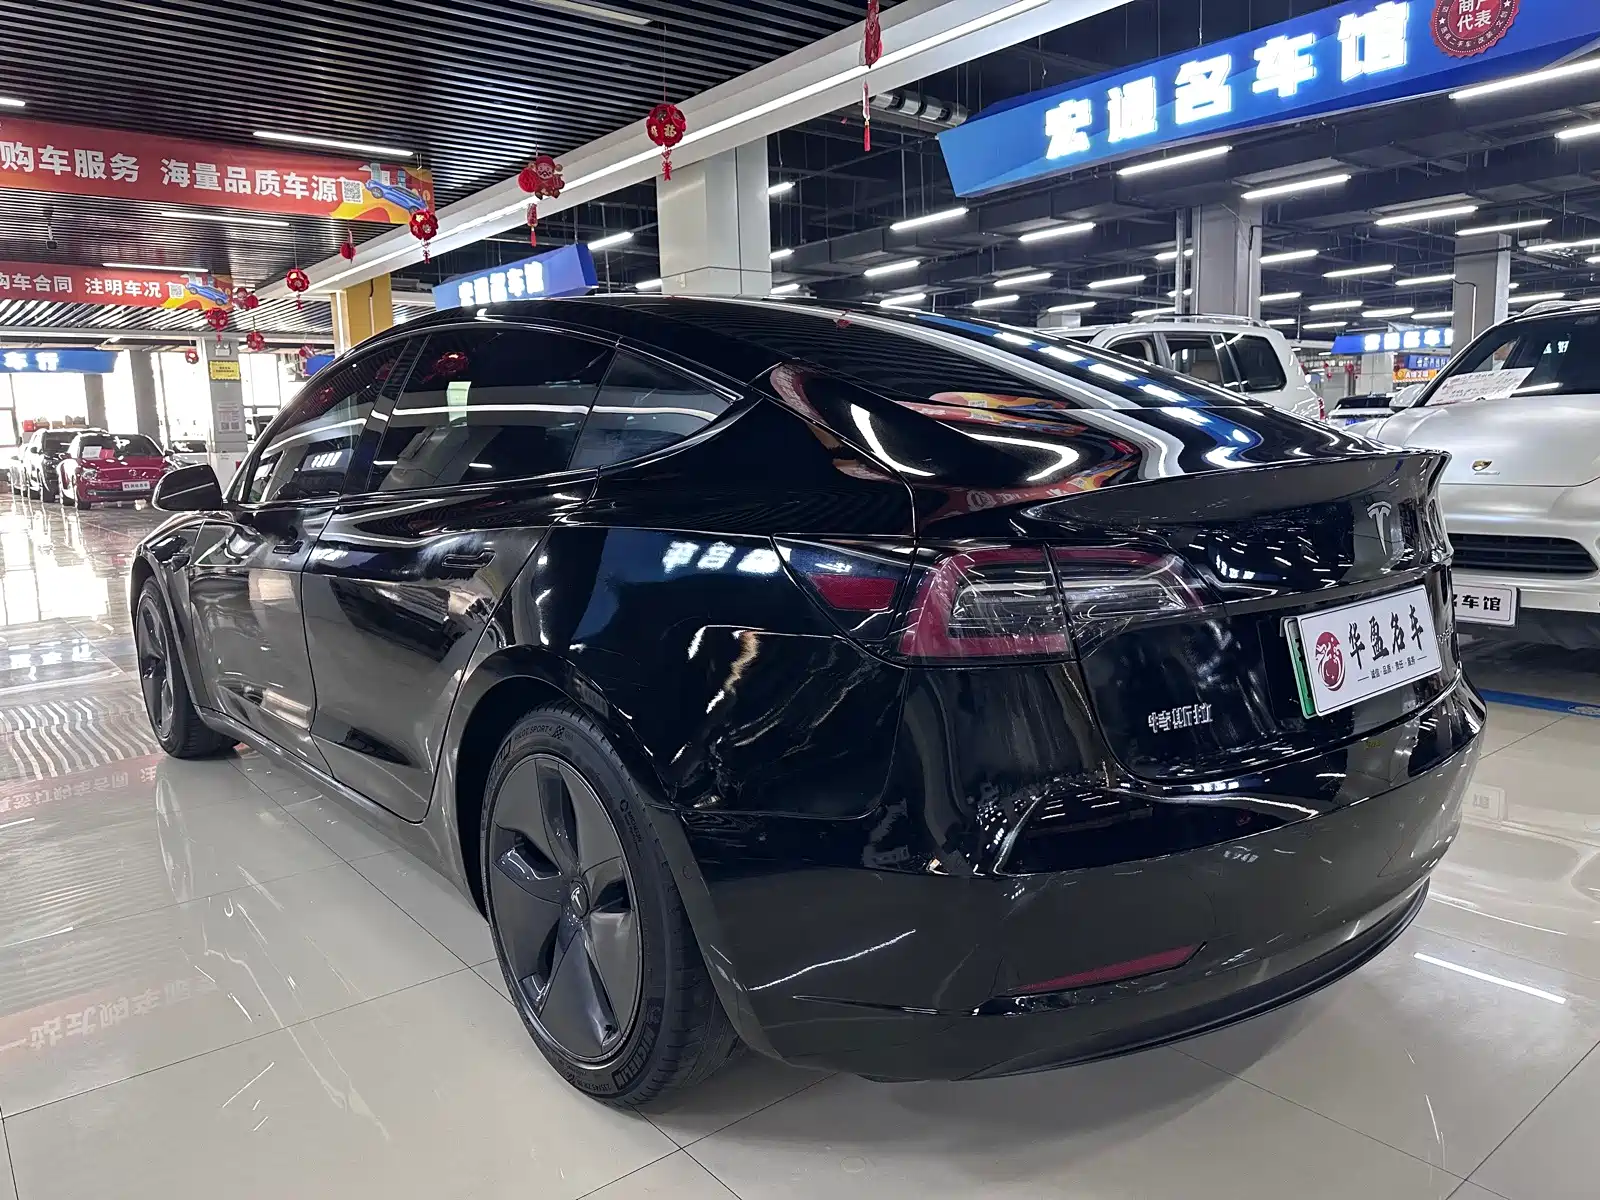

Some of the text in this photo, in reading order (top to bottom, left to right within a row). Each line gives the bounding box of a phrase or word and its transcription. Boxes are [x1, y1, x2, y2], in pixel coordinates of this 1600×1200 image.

[1457, 9, 1492, 32] 代表
[0, 141, 338, 202] 购车服务 海量品质车源
[85, 277, 162, 298] 注明车况
[1453, 594, 1502, 612] 车馆
[1148, 703, 1213, 733] 特斯拉
